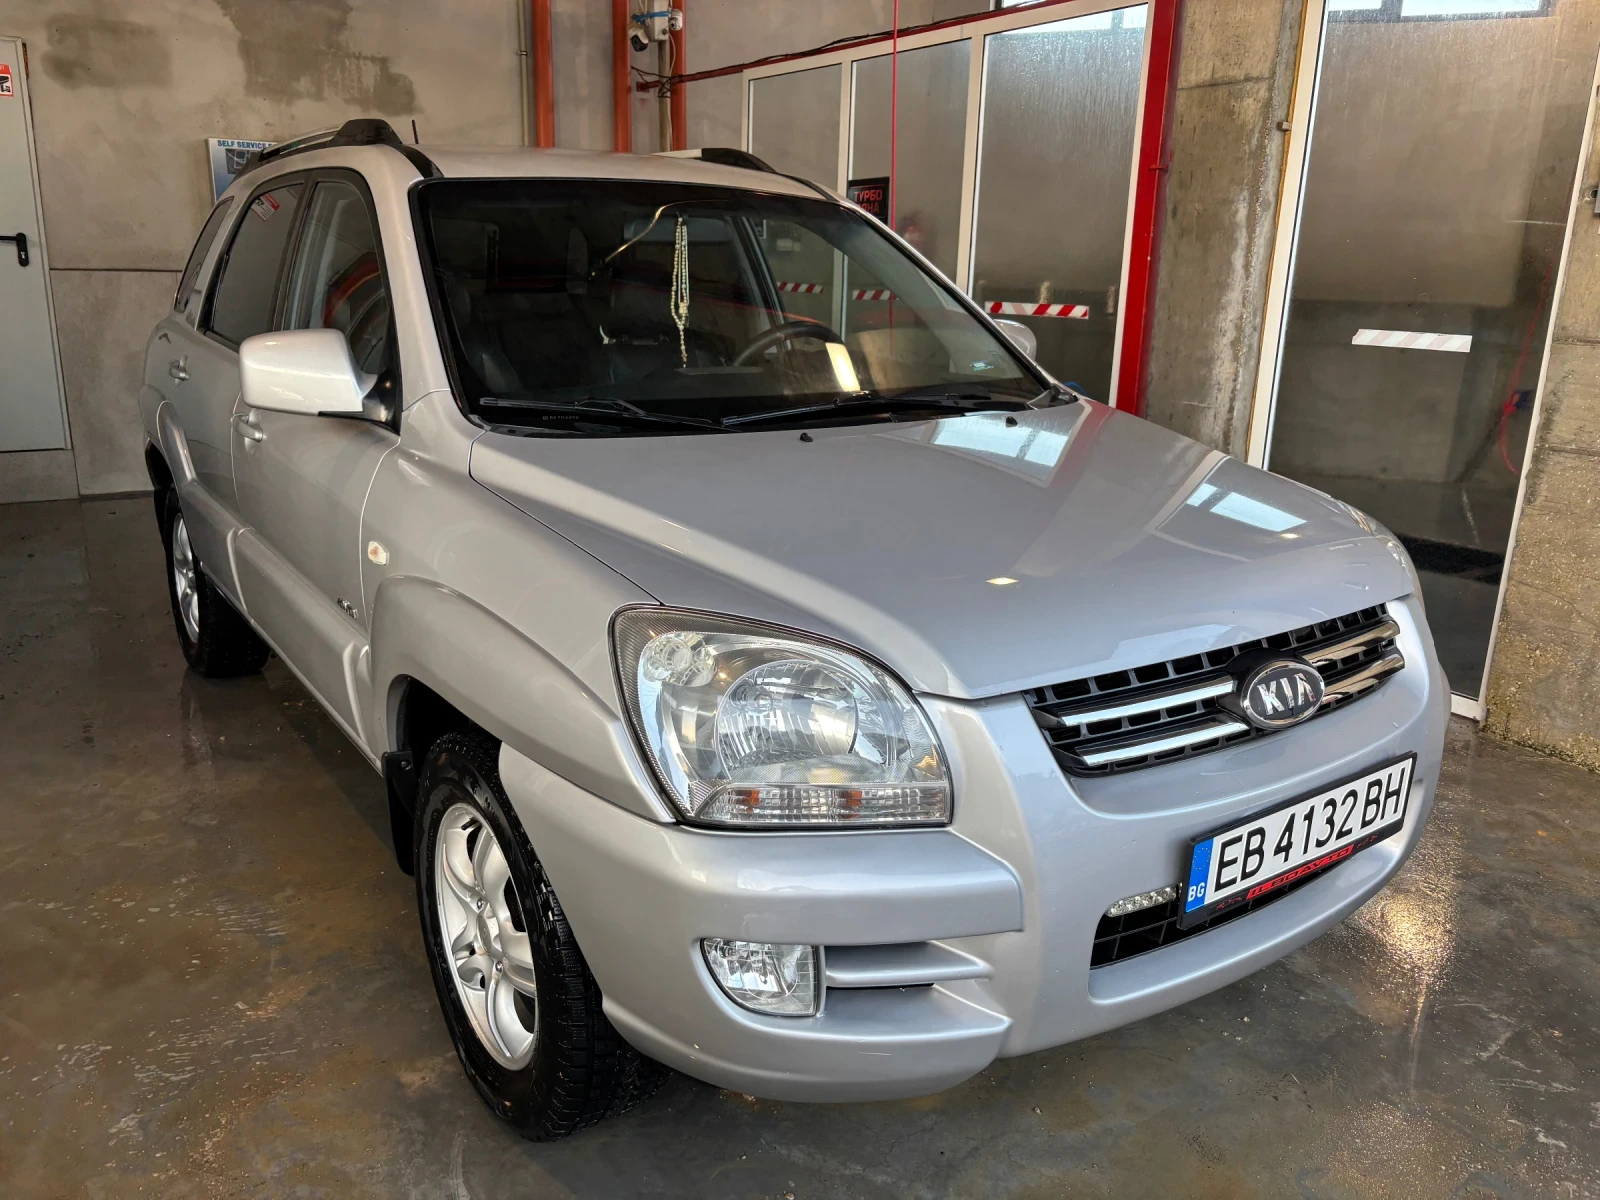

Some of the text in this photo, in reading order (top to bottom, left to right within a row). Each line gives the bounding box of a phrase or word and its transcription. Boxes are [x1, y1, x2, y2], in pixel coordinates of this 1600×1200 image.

[217, 140, 235, 148] SELF
[236, 142, 266, 150] SERVICE
[854, 189, 883, 202] ТУРБО
[1257, 673, 1316, 716] KIA
[1213, 766, 1406, 893] EB 4132 BH
[1187, 881, 1206, 902] BG
